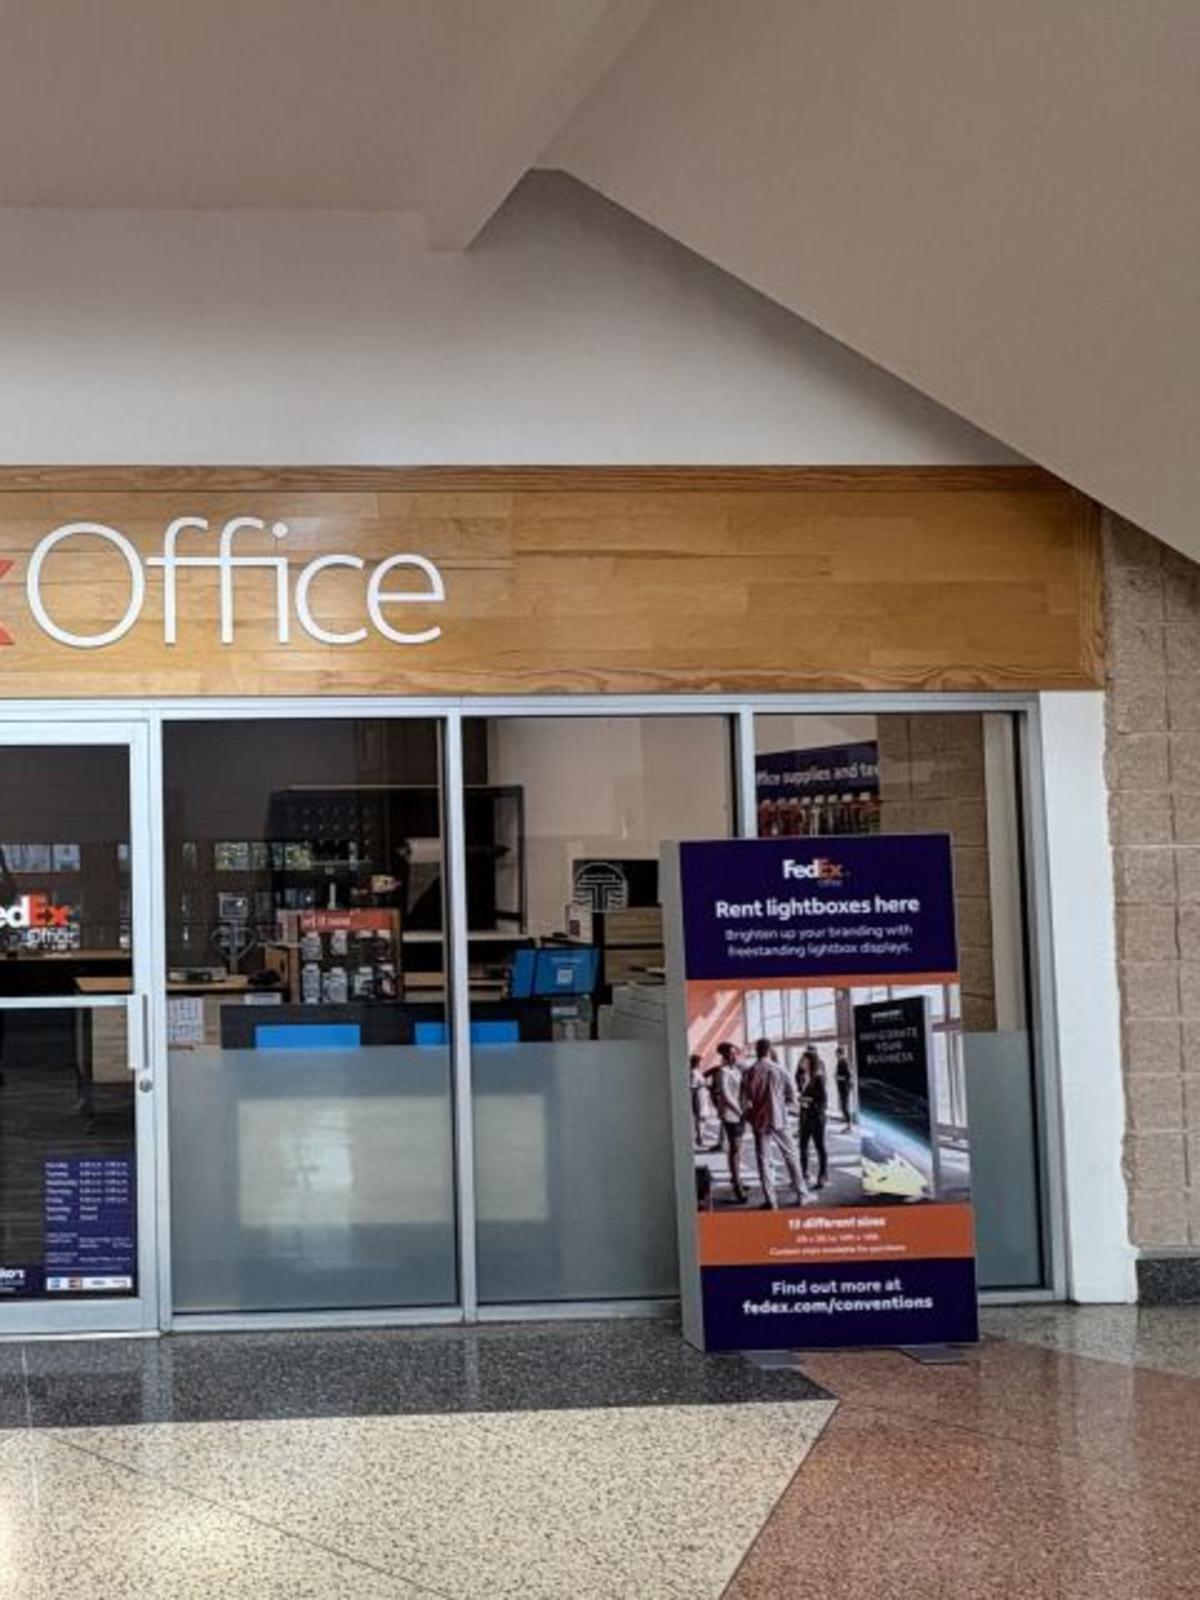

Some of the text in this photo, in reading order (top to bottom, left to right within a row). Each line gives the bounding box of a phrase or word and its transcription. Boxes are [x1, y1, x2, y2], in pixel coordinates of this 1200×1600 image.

[26, 516, 446, 648] Office
[782, 859, 844, 879] FedEx
[715, 895, 921, 920] Rent lightboxes here
[885, 924, 914, 937] with
[771, 1276, 903, 1295] Find out more at
[742, 1295, 934, 1315] fedex.com/conventions
